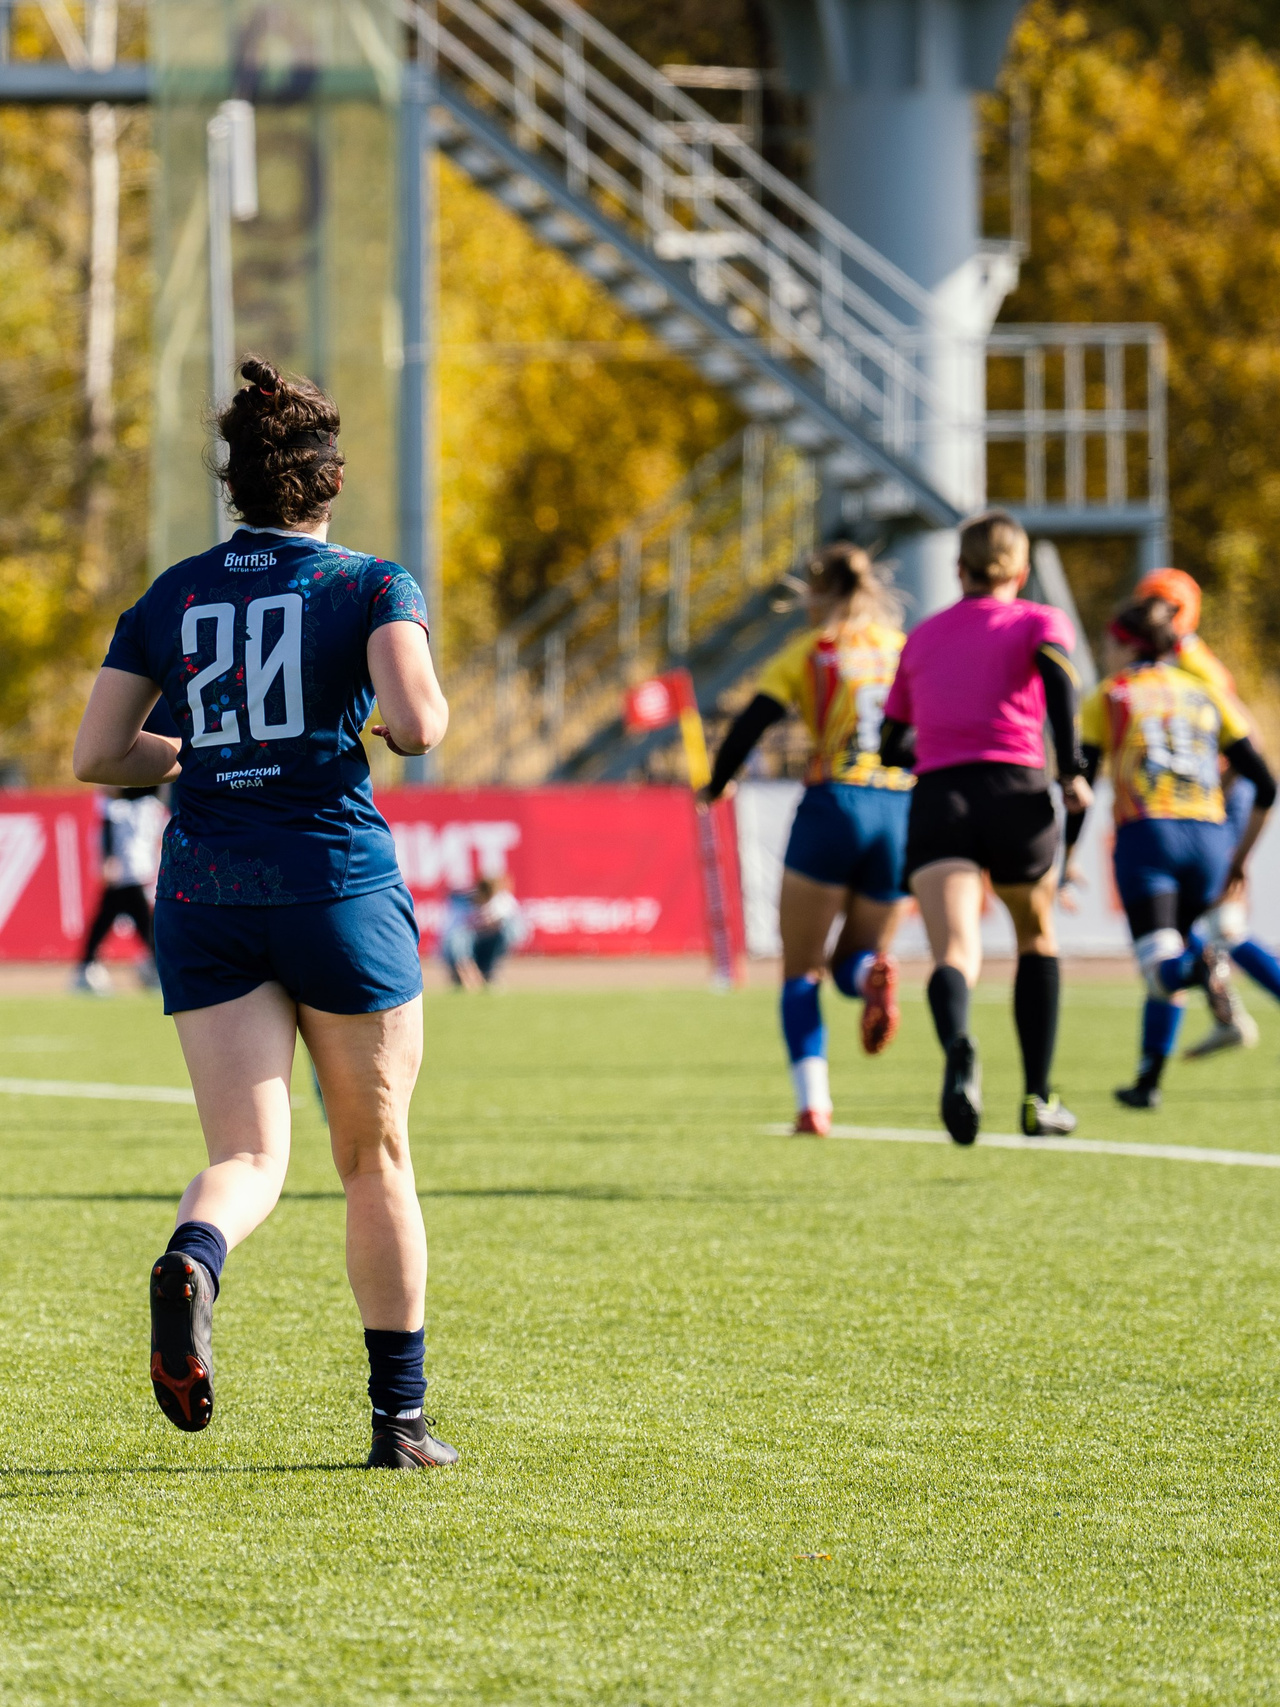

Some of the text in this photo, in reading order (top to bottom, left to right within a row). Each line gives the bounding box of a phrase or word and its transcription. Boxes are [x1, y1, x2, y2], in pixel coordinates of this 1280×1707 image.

[181, 593, 305, 748] 20
[216, 764, 281, 782] ПЕРМСКИЙ
[230, 777, 263, 790] КРАЙ
